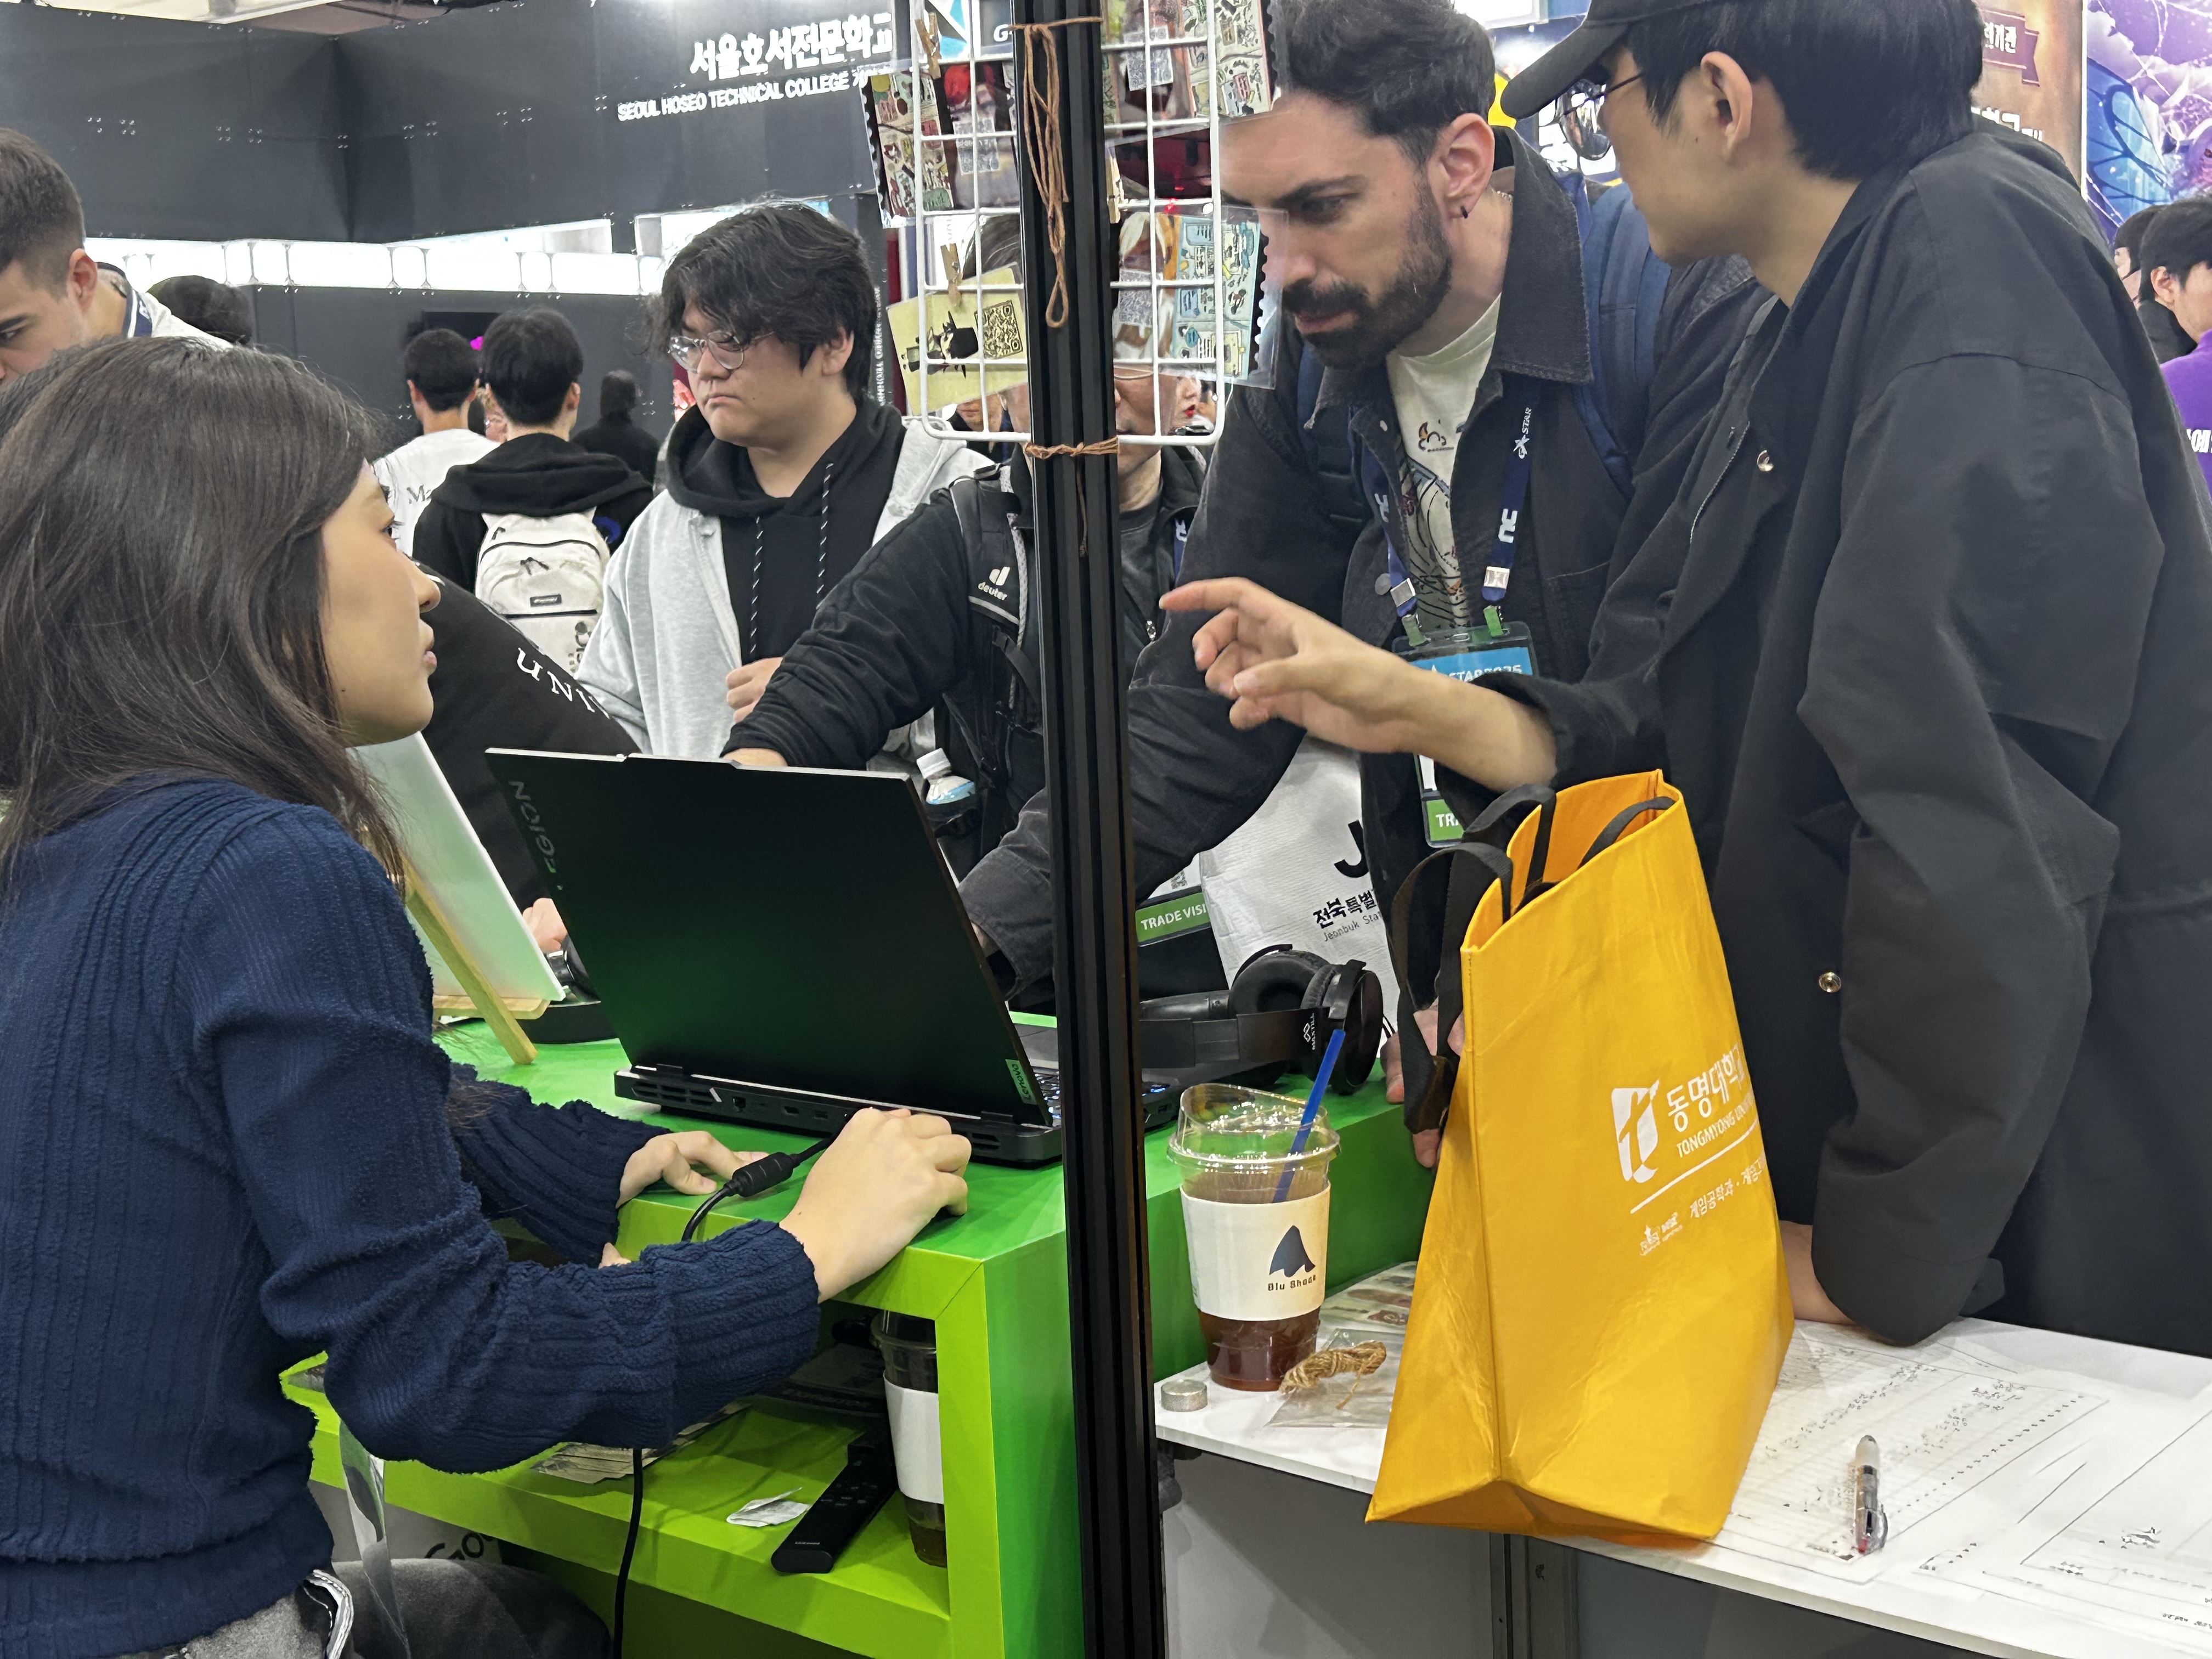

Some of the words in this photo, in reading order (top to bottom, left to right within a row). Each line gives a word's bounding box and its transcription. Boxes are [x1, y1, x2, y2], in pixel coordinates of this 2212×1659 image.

[617, 99, 661, 122] SEOUL
[661, 92, 708, 115] HOSEO
[708, 82, 785, 109] TECHNICAL
[785, 71, 850, 99] COLLEGE
[977, 582, 1008, 601] deuter
[1435, 812, 1459, 828] TR
[1140, 910, 1183, 930] TRADE
[1182, 903, 1207, 918] VISI
[1312, 889, 1378, 929] 전북특별
[1323, 920, 1361, 943] Jeonbuk
[1011, 1063, 1031, 1101] Lenovo
[1676, 1110, 1736, 1158] TONGMYONG
[1267, 1282, 1285, 1291] Blu
